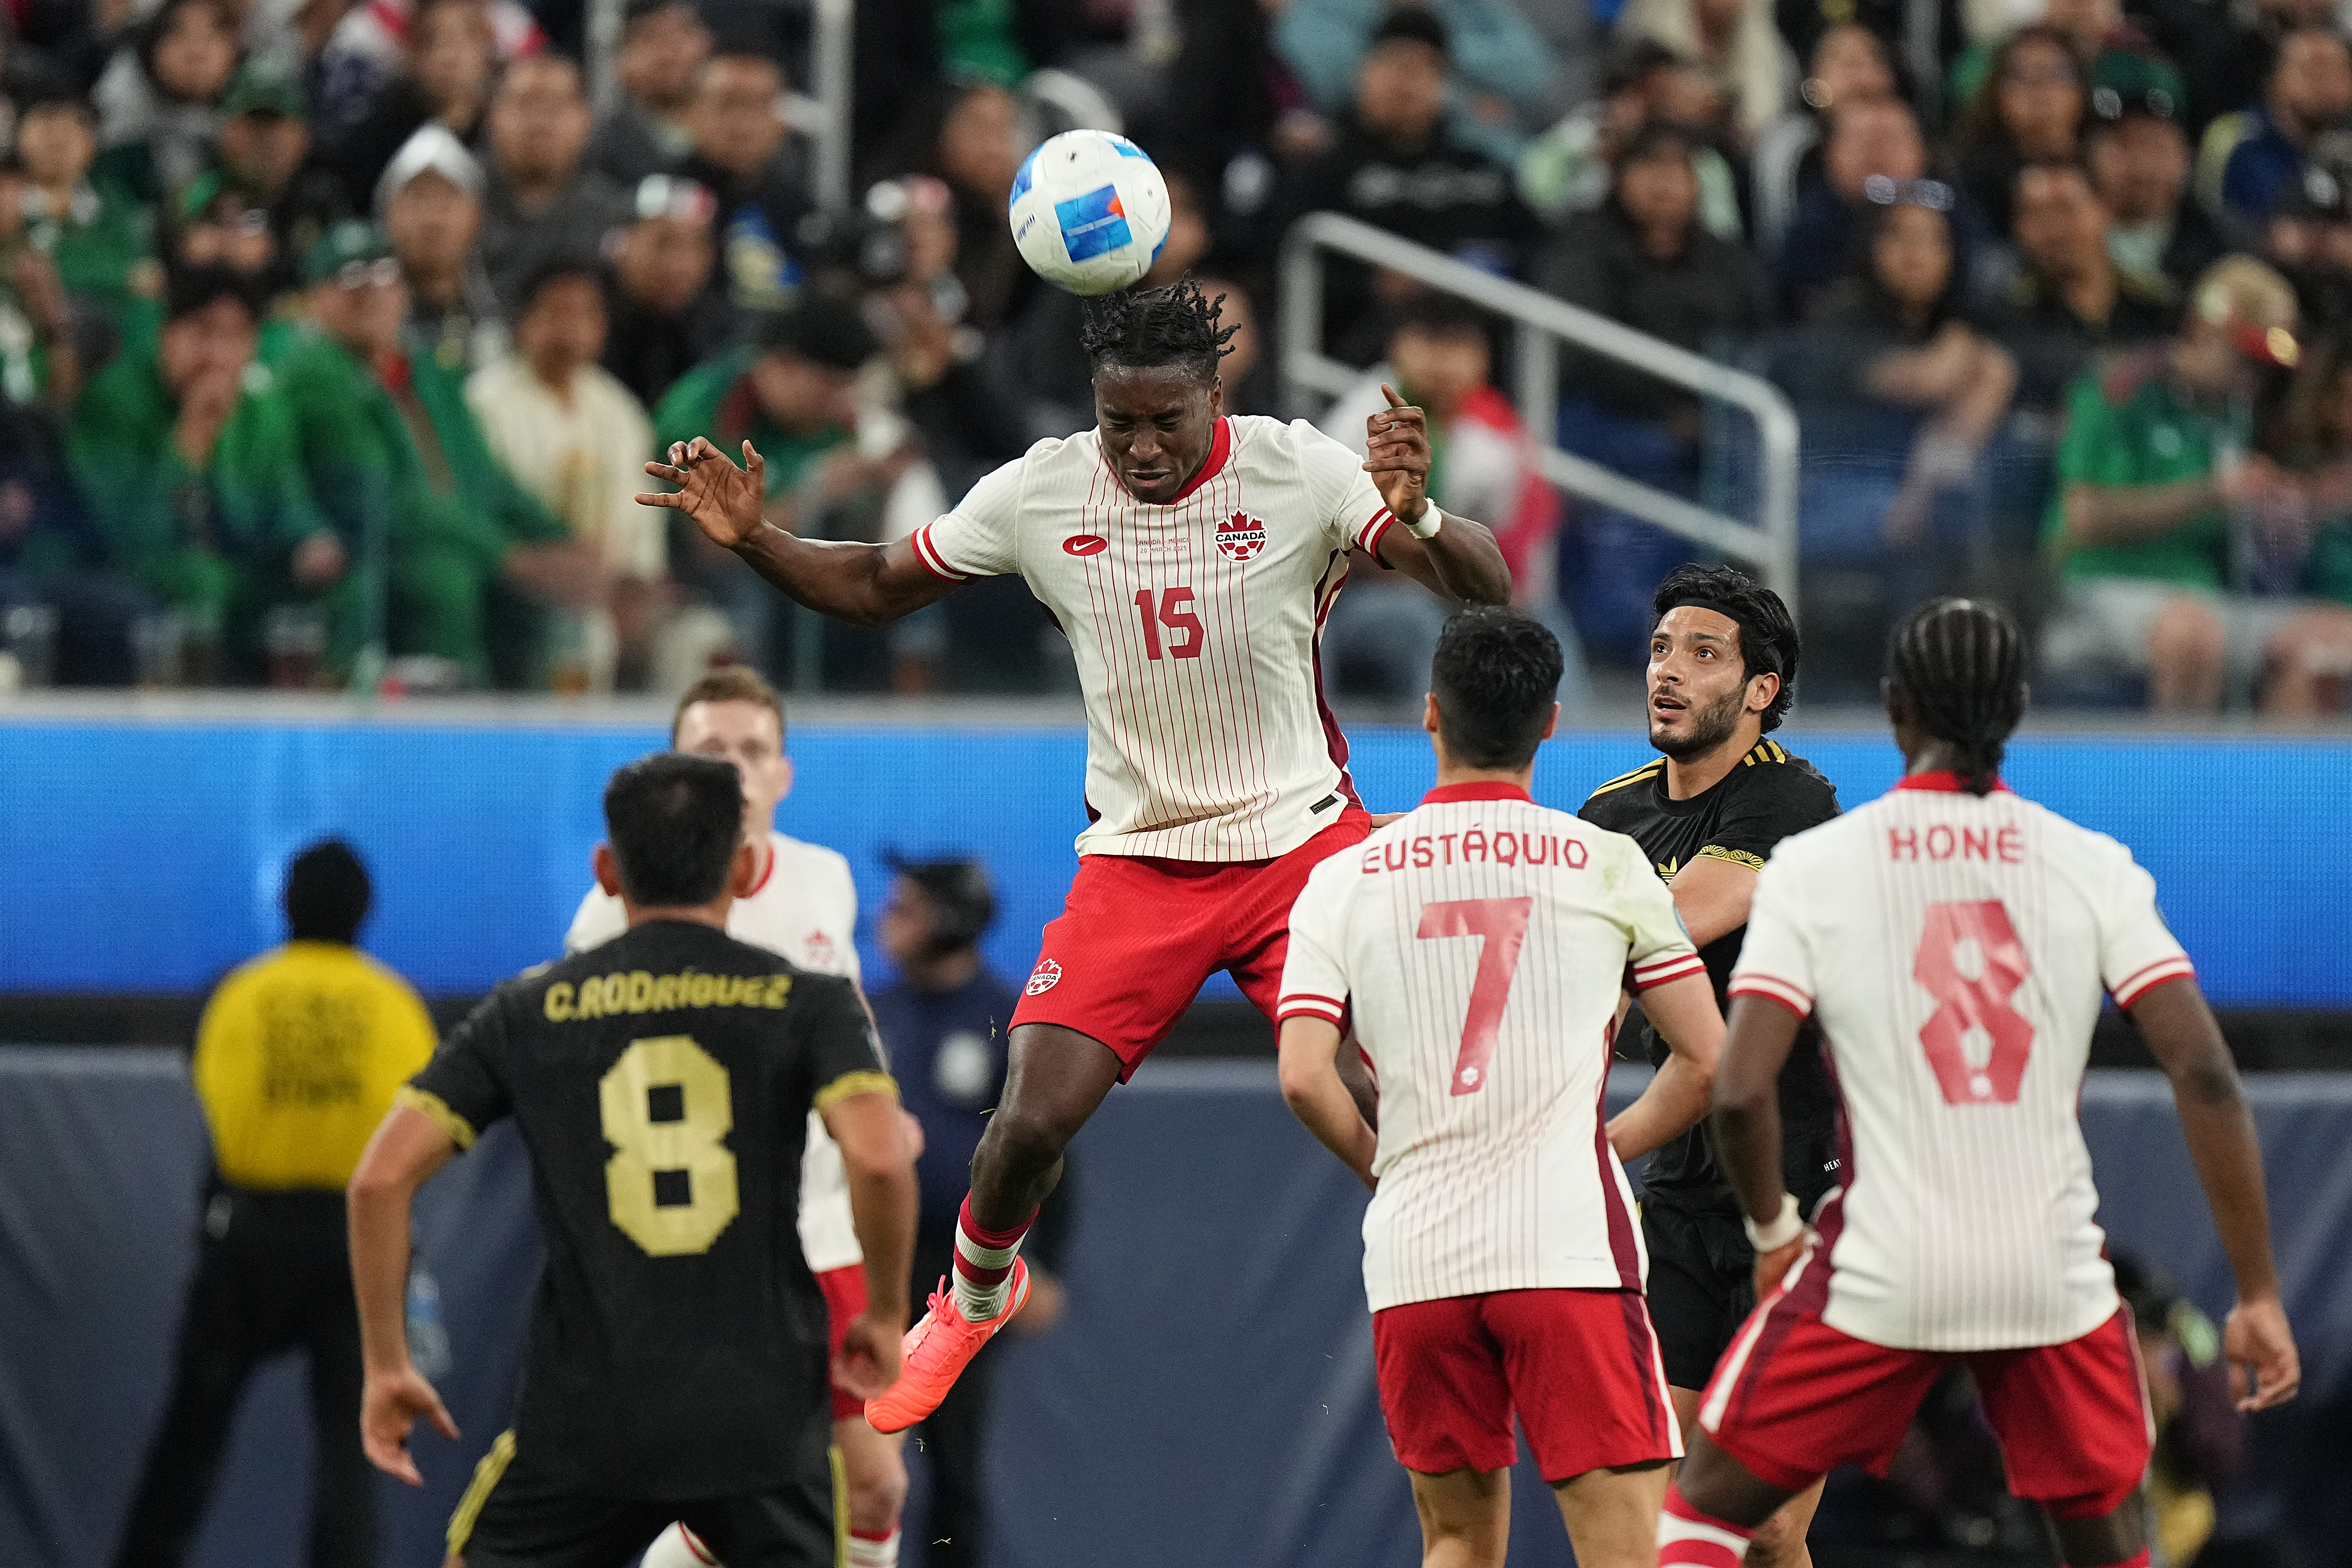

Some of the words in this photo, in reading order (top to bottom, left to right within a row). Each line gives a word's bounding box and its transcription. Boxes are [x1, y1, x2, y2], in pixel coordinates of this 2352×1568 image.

[1215, 532, 1266, 542] CANADA
[1135, 587, 1204, 660] 15
[1362, 823, 1588, 874] EUSTÁQUIO
[1417, 896, 1533, 1097] 7
[1913, 899, 2035, 1105] 8
[599, 1033, 741, 1257] 8
